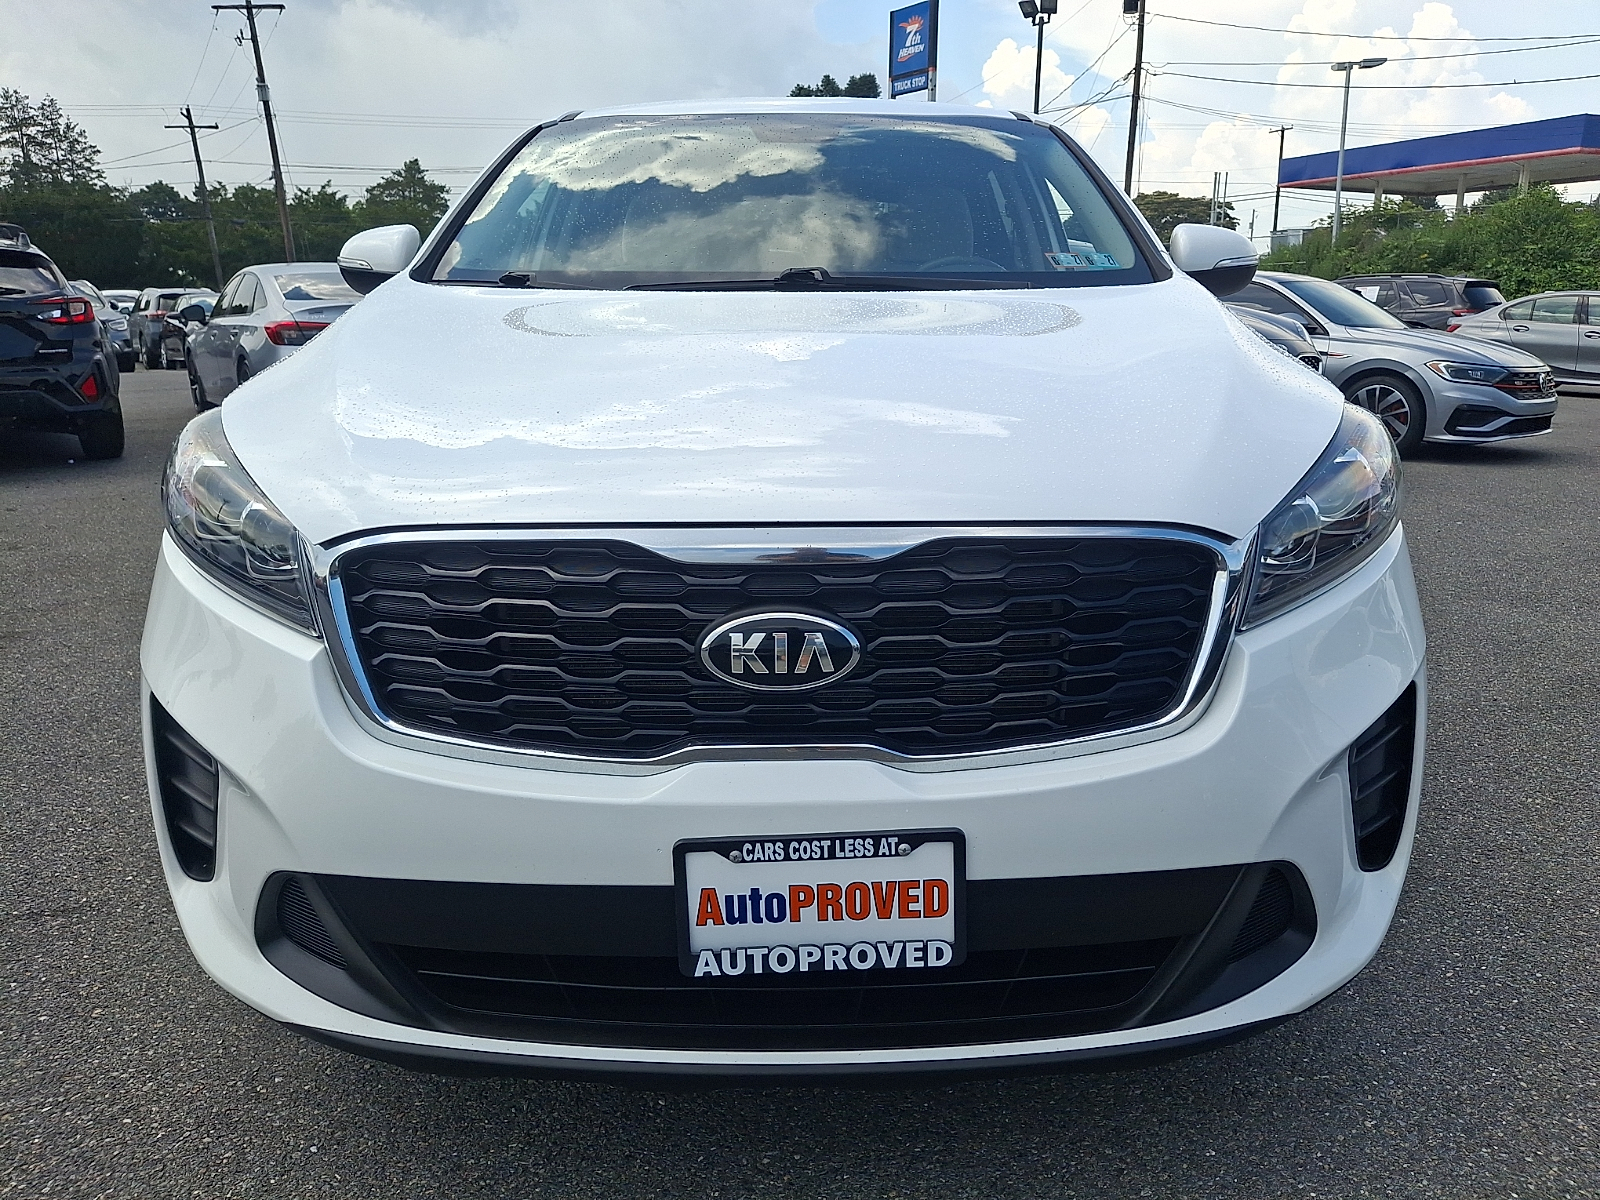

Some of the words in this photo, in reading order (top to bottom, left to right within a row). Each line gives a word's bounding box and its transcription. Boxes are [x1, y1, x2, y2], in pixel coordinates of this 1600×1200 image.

[906, 24, 921, 47] 7th
[898, 44, 925, 58] HEAVEN
[894, 80, 911, 91] TRUCK
[912, 76, 926, 87] STOP
[729, 632, 835, 674] KIA
[742, 842, 785, 862] CARS
[789, 840, 831, 860] COST
[835, 838, 874, 858] LESS
[878, 837, 899, 856] AT
[695, 878, 950, 927] AutoPROVED
[694, 940, 953, 977] AUTOPROVED
